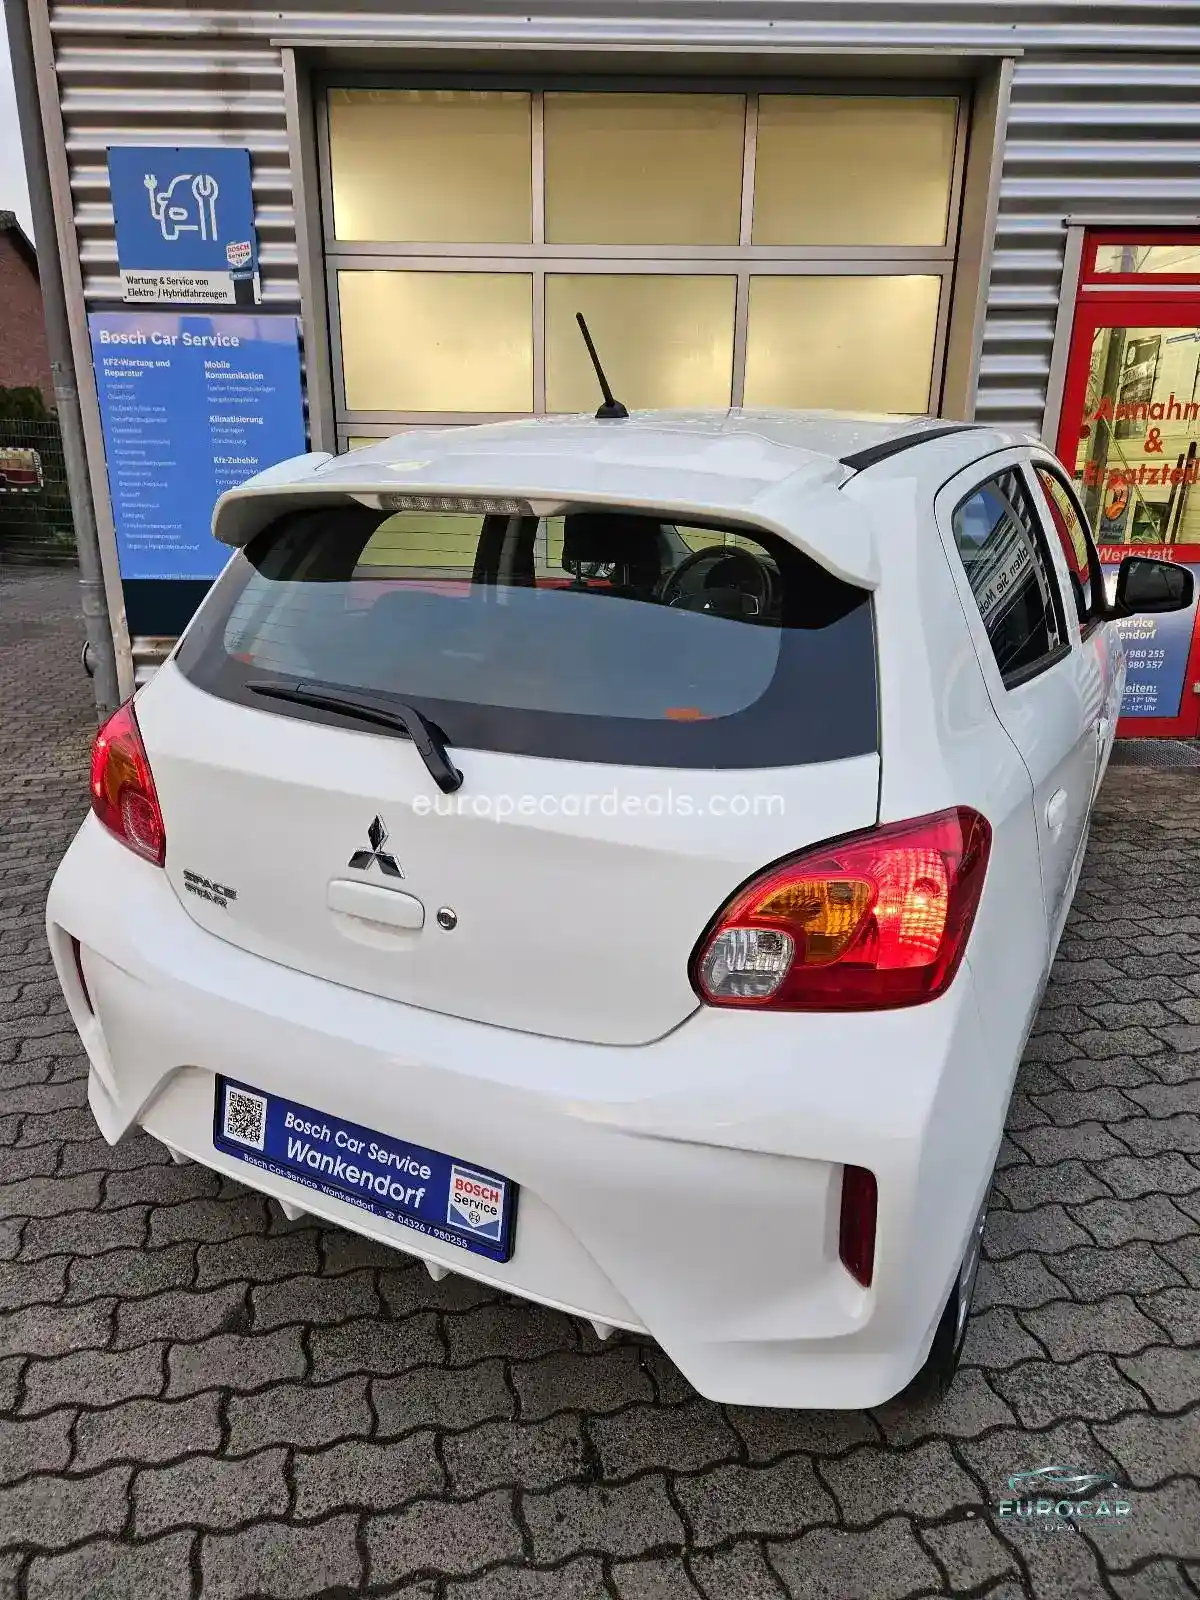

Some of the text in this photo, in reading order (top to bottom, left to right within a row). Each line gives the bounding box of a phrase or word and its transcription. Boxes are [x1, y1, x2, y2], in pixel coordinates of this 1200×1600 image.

[126, 276, 158, 287] Wartung
[159, 277, 165, 285] &
[166, 277, 194, 286] Service
[162, 288, 228, 299] Hybridfahrzeugen
[100, 330, 240, 347] Bosch Car Service
[155, 359, 171, 367] und
[204, 360, 231, 369] Mobile
[104, 369, 144, 379] Reparatur
[205, 371, 264, 380] Kommunikation
[209, 415, 264, 425] Klimatisierung
[1144, 427, 1163, 453] &
[213, 456, 259, 465] Kfz-Zubehör
[1096, 545, 1174, 561] Werkstatt
[1116, 617, 1154, 628] Service
[1130, 650, 1147, 658] 980
[1148, 650, 1166, 658] 255
[1128, 660, 1163, 669] 980 557
[1124, 683, 1157, 693] eiten:
[182, 868, 238, 900] SPACE
[184, 880, 228, 909] STAR
[284, 1111, 432, 1180] Bosch Car Service
[286, 1136, 426, 1209] Wankendorf
[453, 1177, 500, 1203] BOSCH
[243, 1152, 268, 1169] Bosch
[320, 1182, 375, 1212] Wankendorf
[397, 1214, 426, 1233] 04326
[433, 1228, 468, 1248] 980255
[453, 1192, 498, 1216] Service
